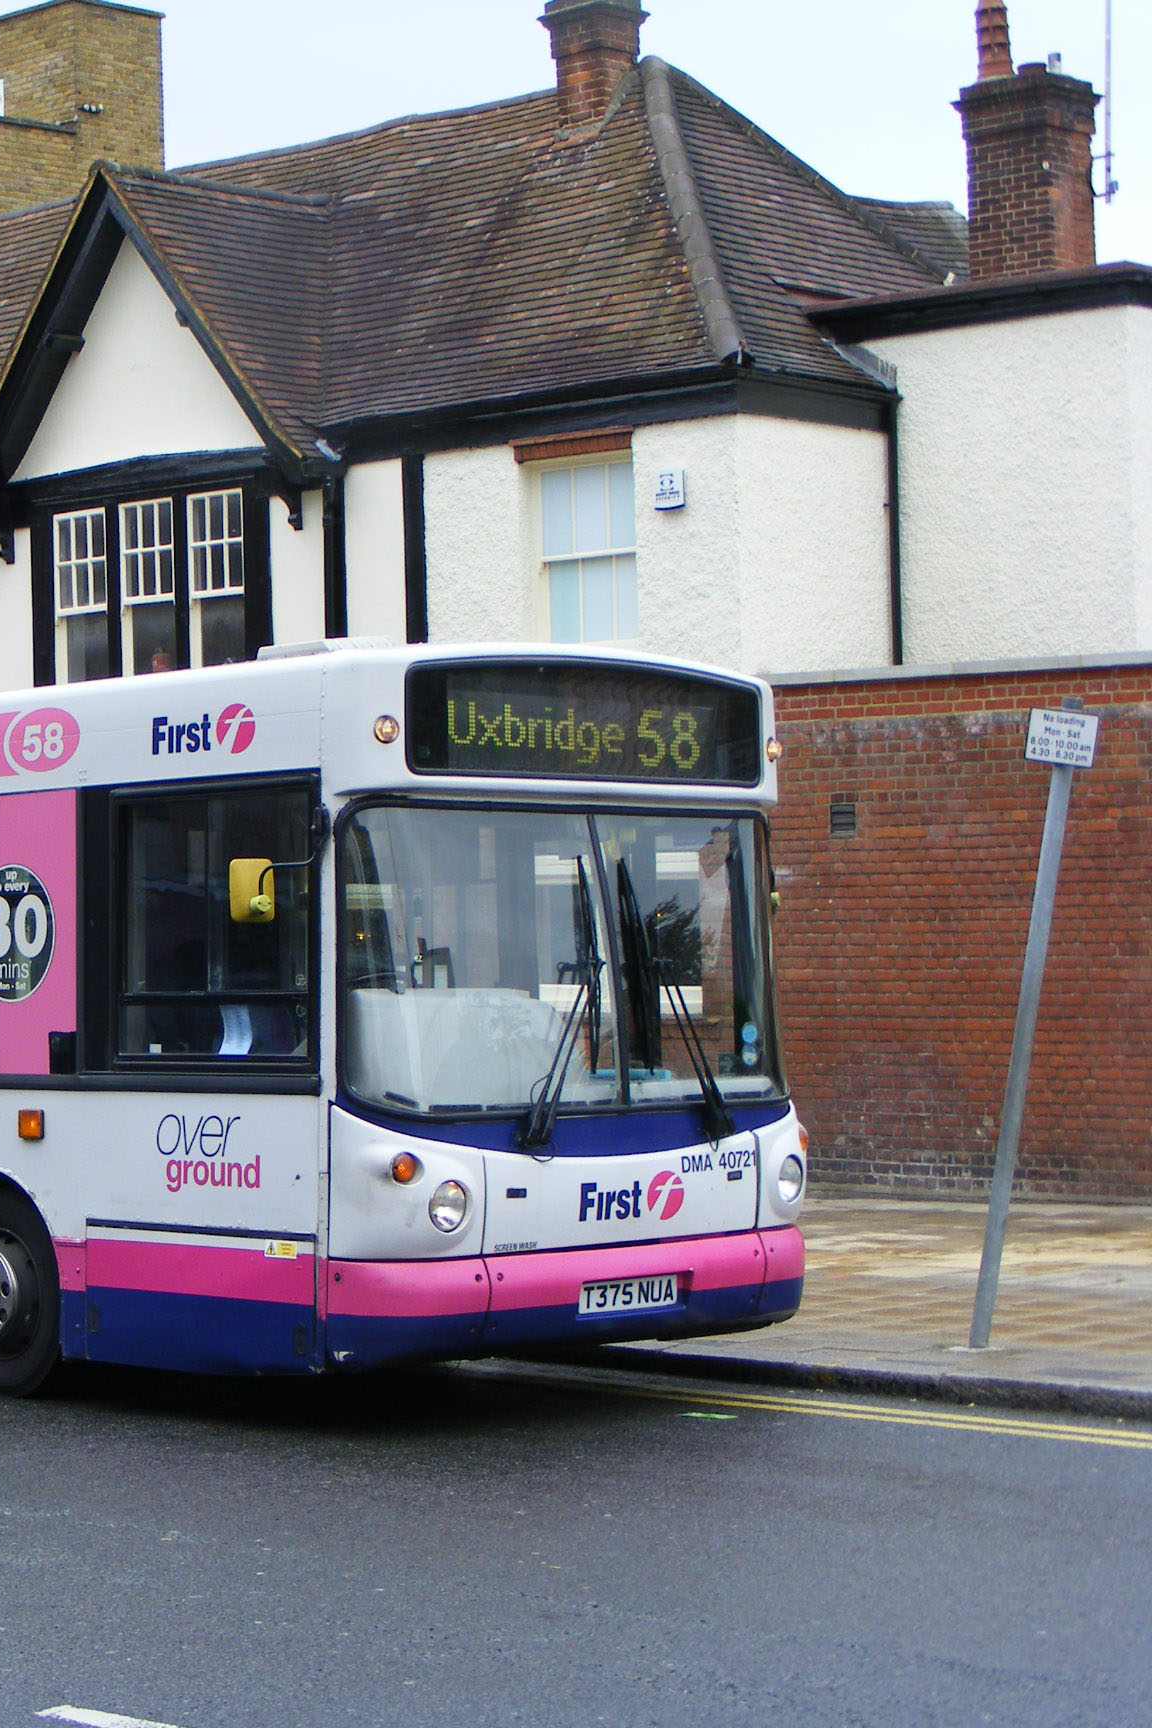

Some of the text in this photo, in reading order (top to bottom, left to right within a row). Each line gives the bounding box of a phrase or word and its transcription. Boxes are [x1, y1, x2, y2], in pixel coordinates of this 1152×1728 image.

[152, 713, 211, 755] First
[448, 700, 701, 769] Uxbridge 58
[1043, 713, 1085, 728] No loading
[1066, 730, 1080, 739] Sat
[21, 721, 64, 760] 58
[4, 881, 29, 893] every
[5, 870, 17, 882] up
[15, 981, 26, 990] Sat
[156, 1114, 240, 1157] over
[166, 1155, 261, 1193] ground
[681, 1149, 756, 1174] DMA 40721
[579, 1180, 642, 1222] First
[583, 1278, 674, 1310] T375 NUA
